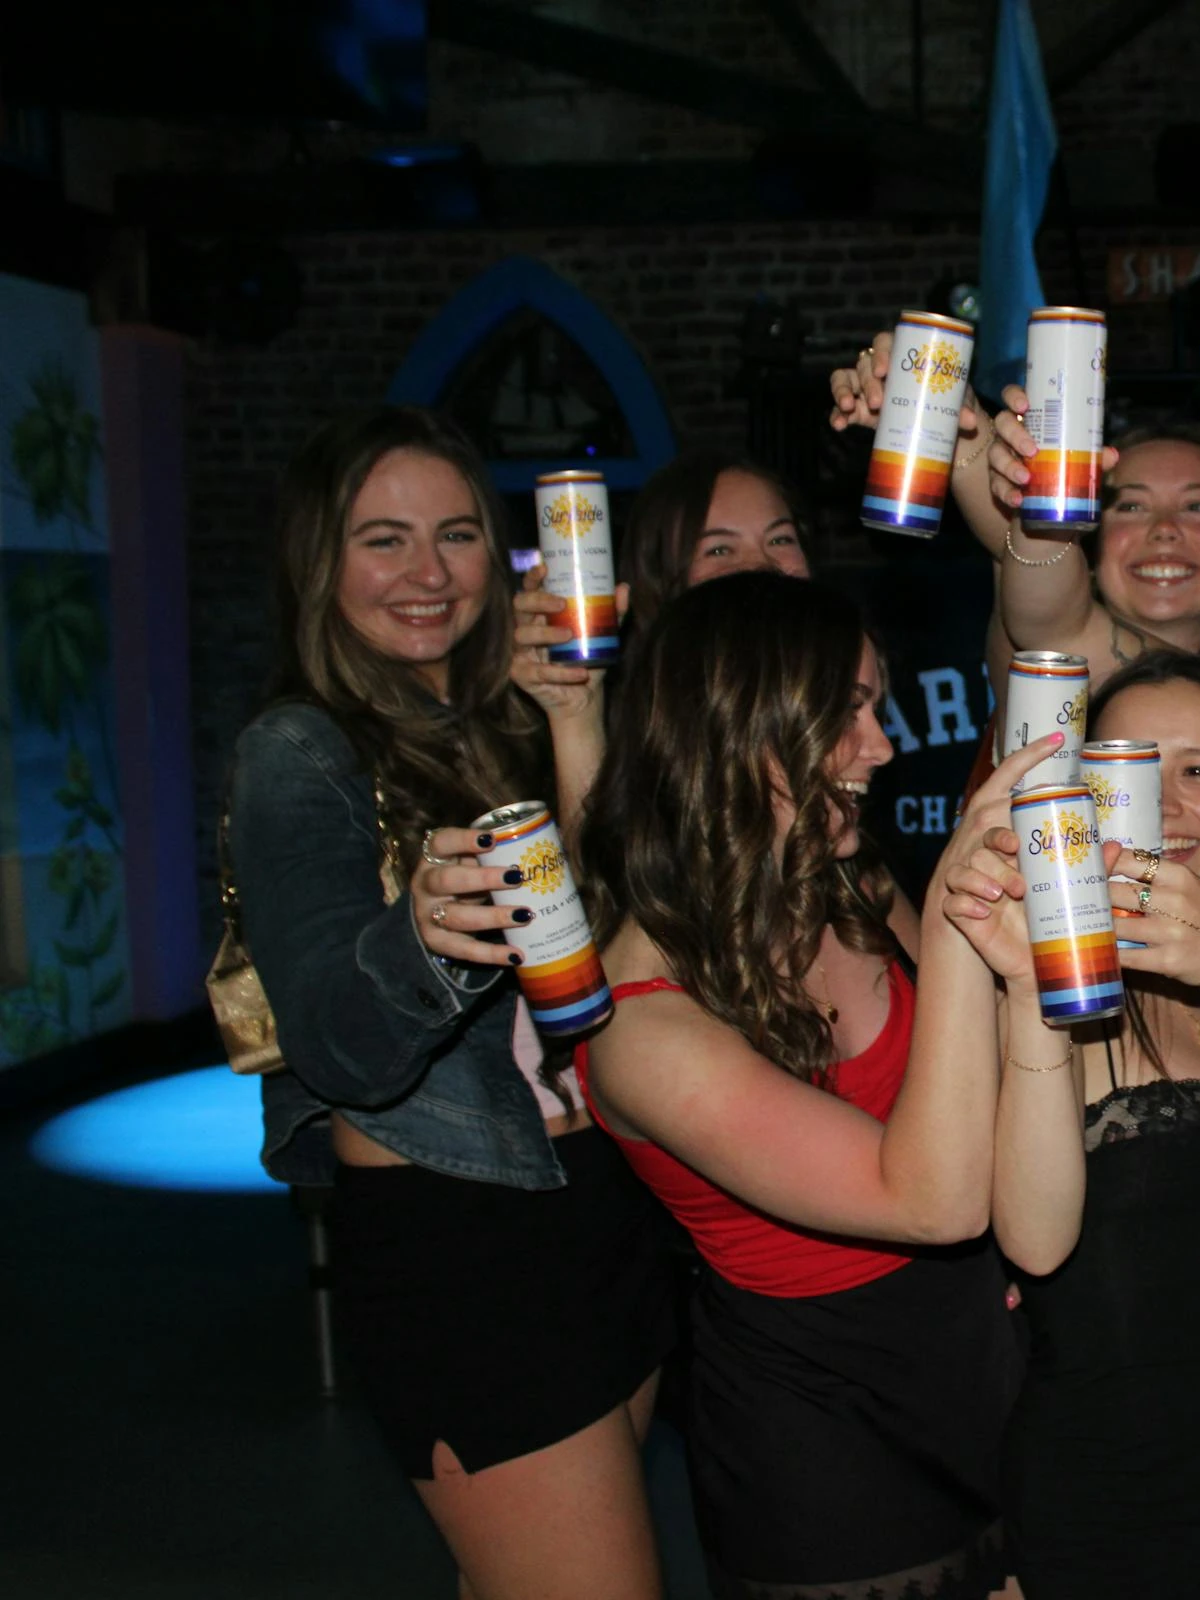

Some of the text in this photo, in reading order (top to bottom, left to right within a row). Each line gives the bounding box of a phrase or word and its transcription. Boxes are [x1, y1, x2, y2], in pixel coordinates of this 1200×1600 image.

[891, 396, 909, 406] ICED
[912, 399, 930, 411] TA
[1056, 701, 1085, 725] Sur
[510, 852, 566, 882] urfsid
[1032, 882, 1051, 893] ICED
[1055, 879, 1074, 889] TA
[539, 904, 559, 917] TEA
